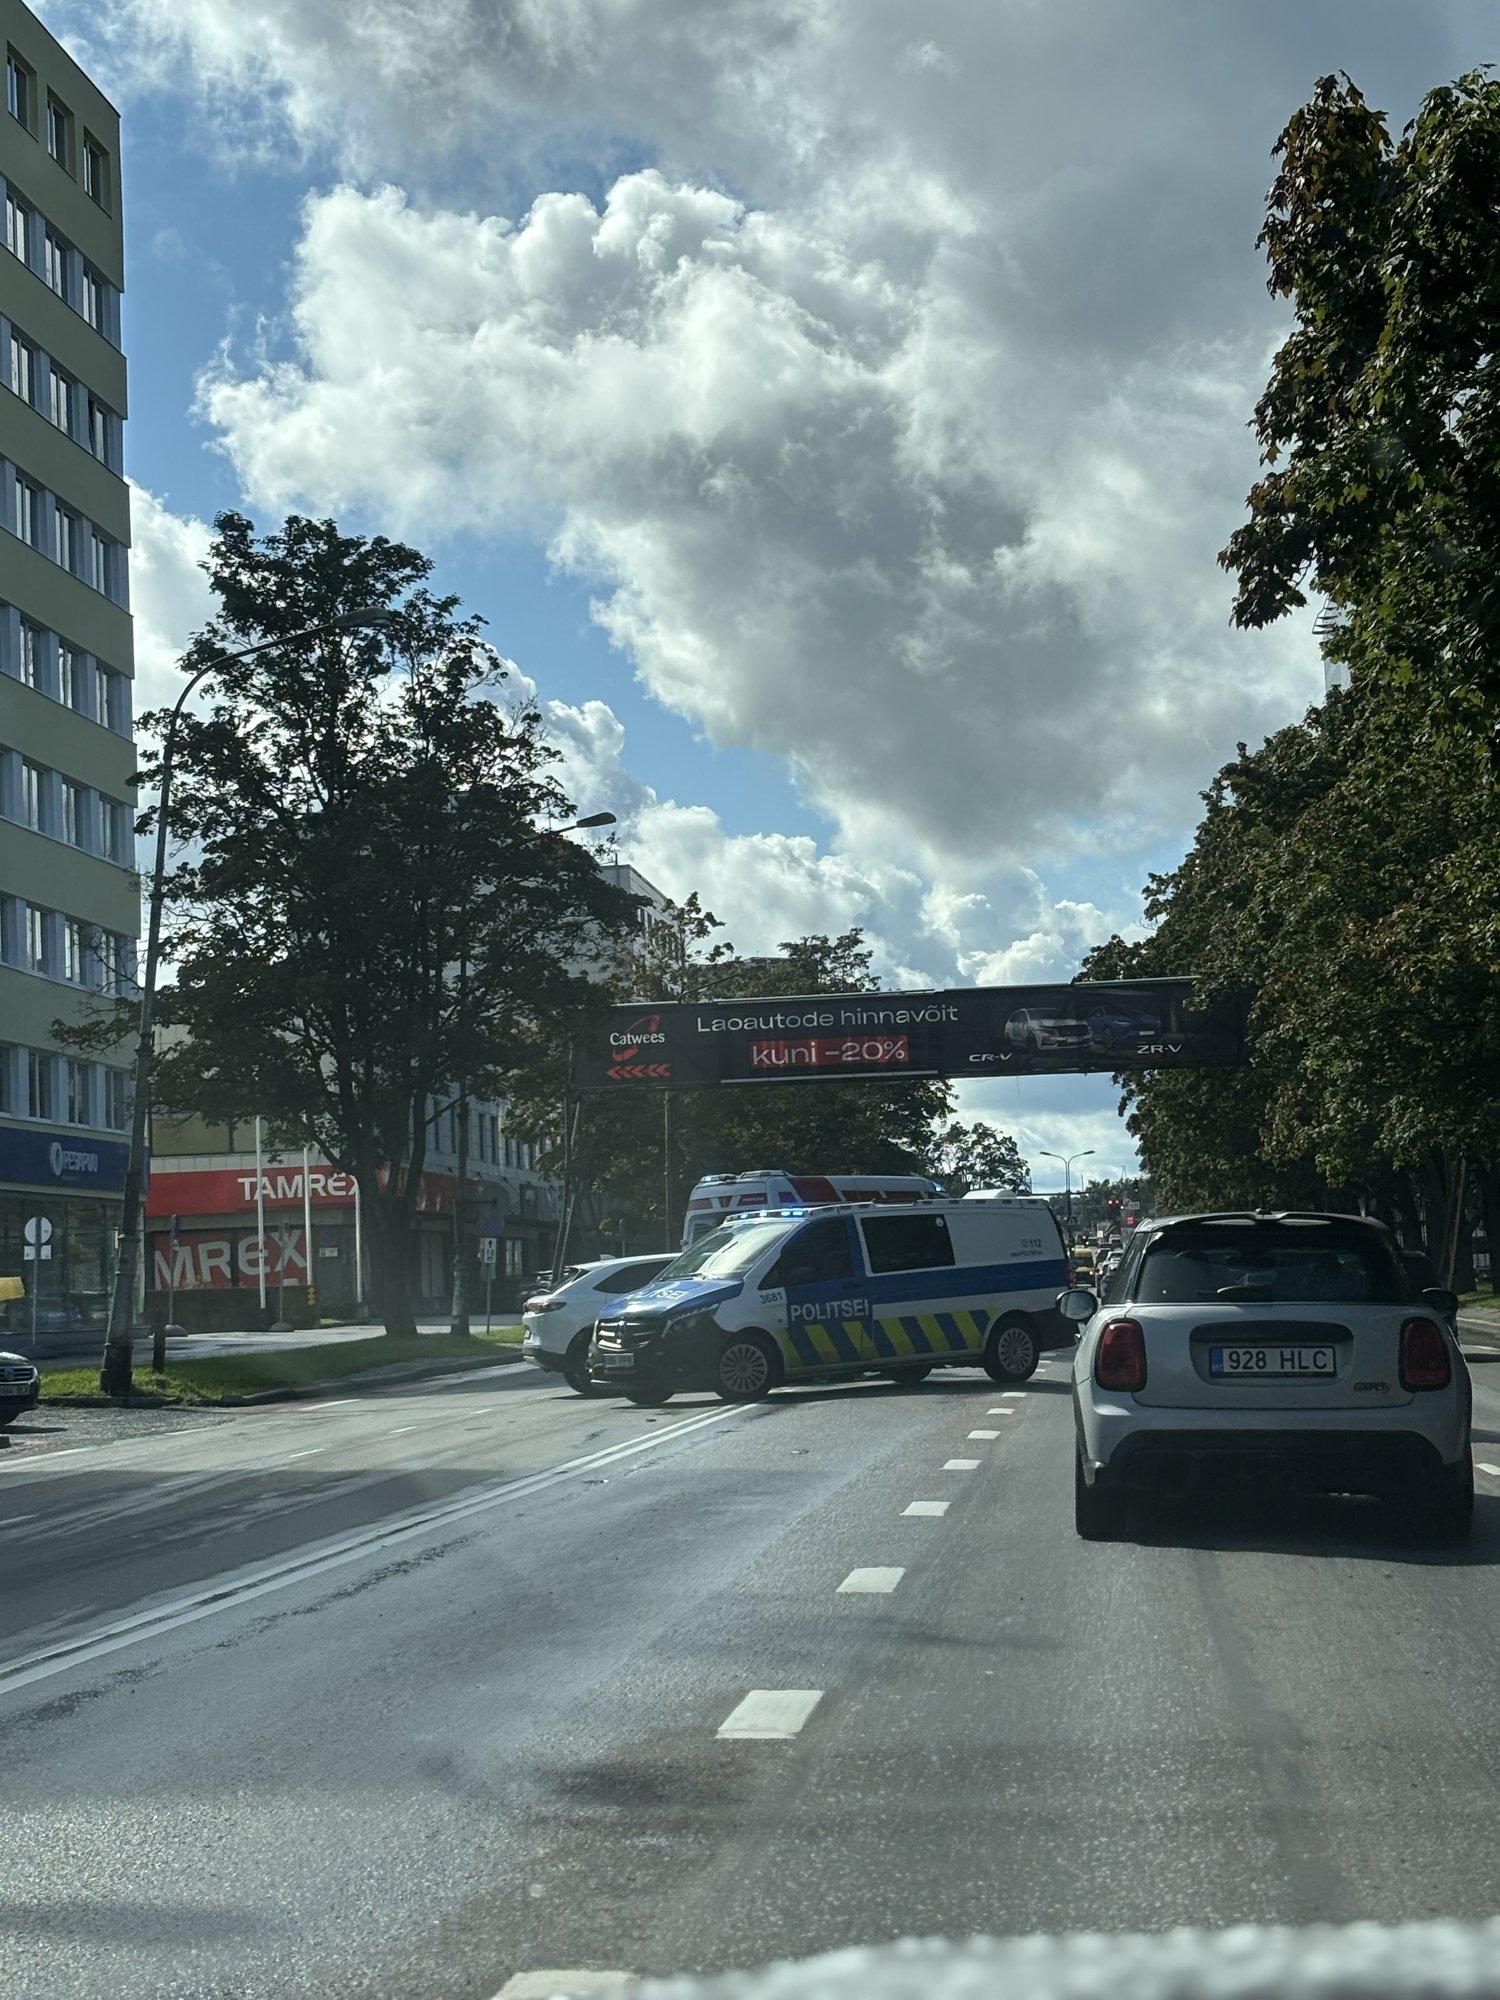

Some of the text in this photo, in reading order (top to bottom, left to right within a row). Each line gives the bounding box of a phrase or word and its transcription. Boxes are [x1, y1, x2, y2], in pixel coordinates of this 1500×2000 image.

[697, 1004, 958, 1032] Laoautode hinnavõit
[609, 1032, 666, 1045] Catwees
[752, 1040, 905, 1065] kuni -20%
[1136, 1043, 1182, 1054] ZR-V
[968, 1052, 1012, 1062] CR-V
[759, 1292, 783, 1304] 3681
[790, 1299, 869, 1322] POLITSEI
[1228, 1350, 1328, 1370] 928 HLC
